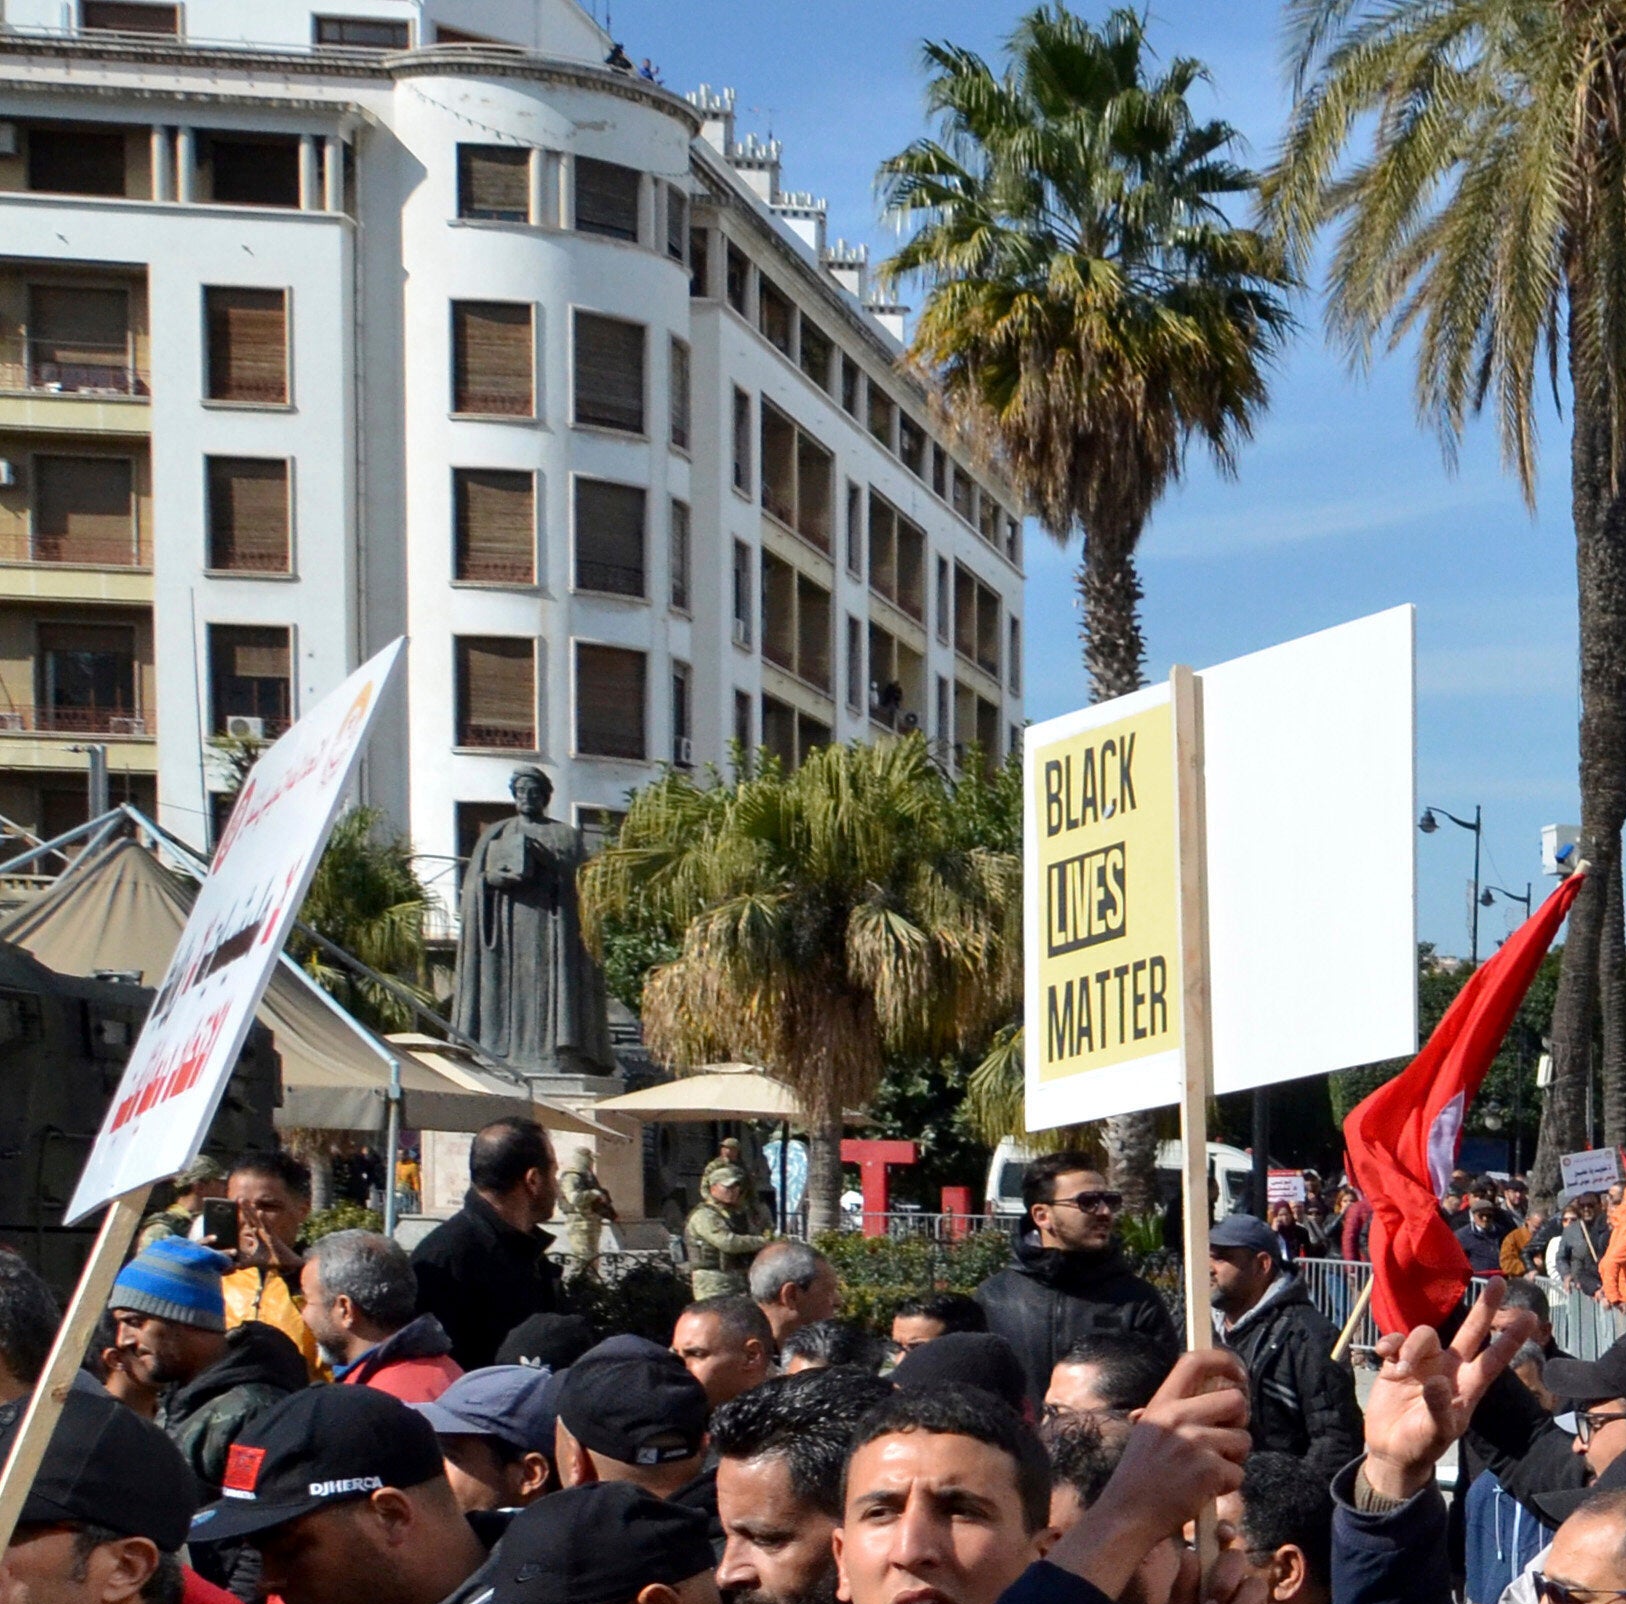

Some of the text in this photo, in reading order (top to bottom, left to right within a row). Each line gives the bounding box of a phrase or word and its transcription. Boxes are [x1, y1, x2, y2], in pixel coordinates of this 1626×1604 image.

[1045, 731, 1137, 838] BLACK
[1051, 846, 1124, 946] LIVES
[1047, 955, 1168, 1063] MATTER
